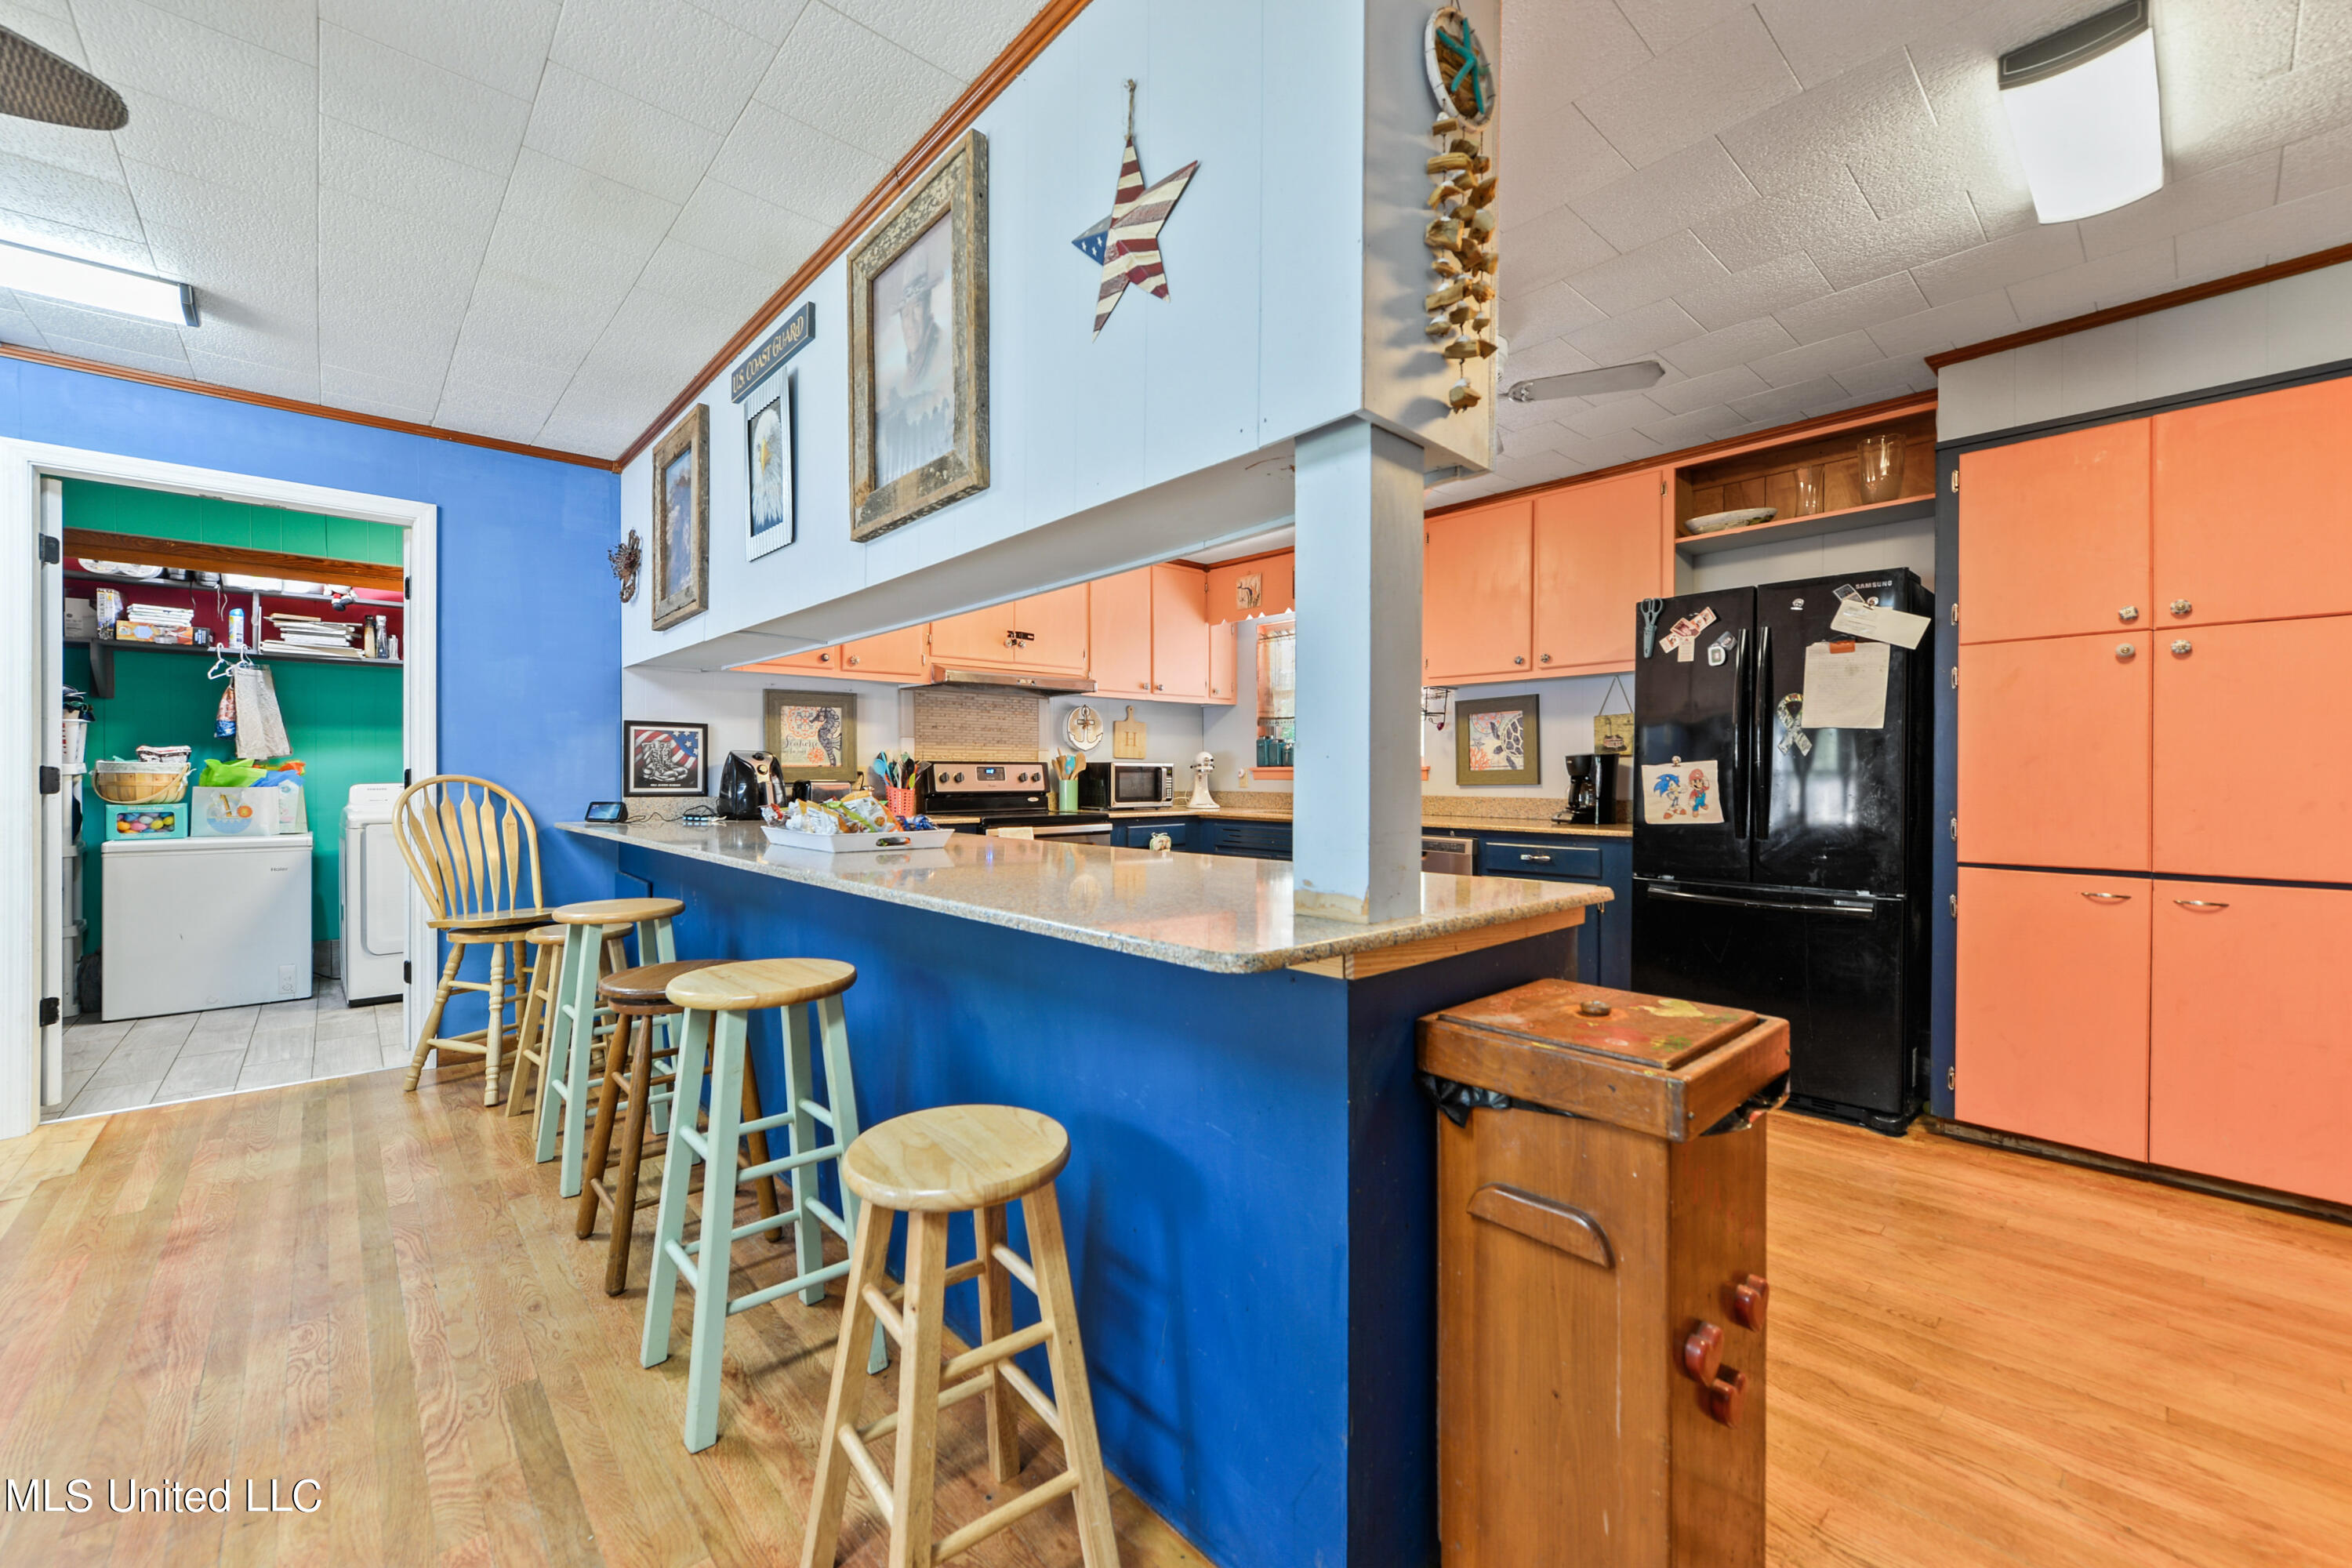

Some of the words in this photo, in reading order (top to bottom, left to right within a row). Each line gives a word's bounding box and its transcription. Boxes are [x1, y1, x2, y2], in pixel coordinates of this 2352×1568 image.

[733, 369, 746, 394] U.S.
[746, 345, 771, 381] COAST
[772, 315, 804, 357] GUARD
[1855, 580, 1893, 590] SAMSUNG
[1123, 731, 1138, 747] H
